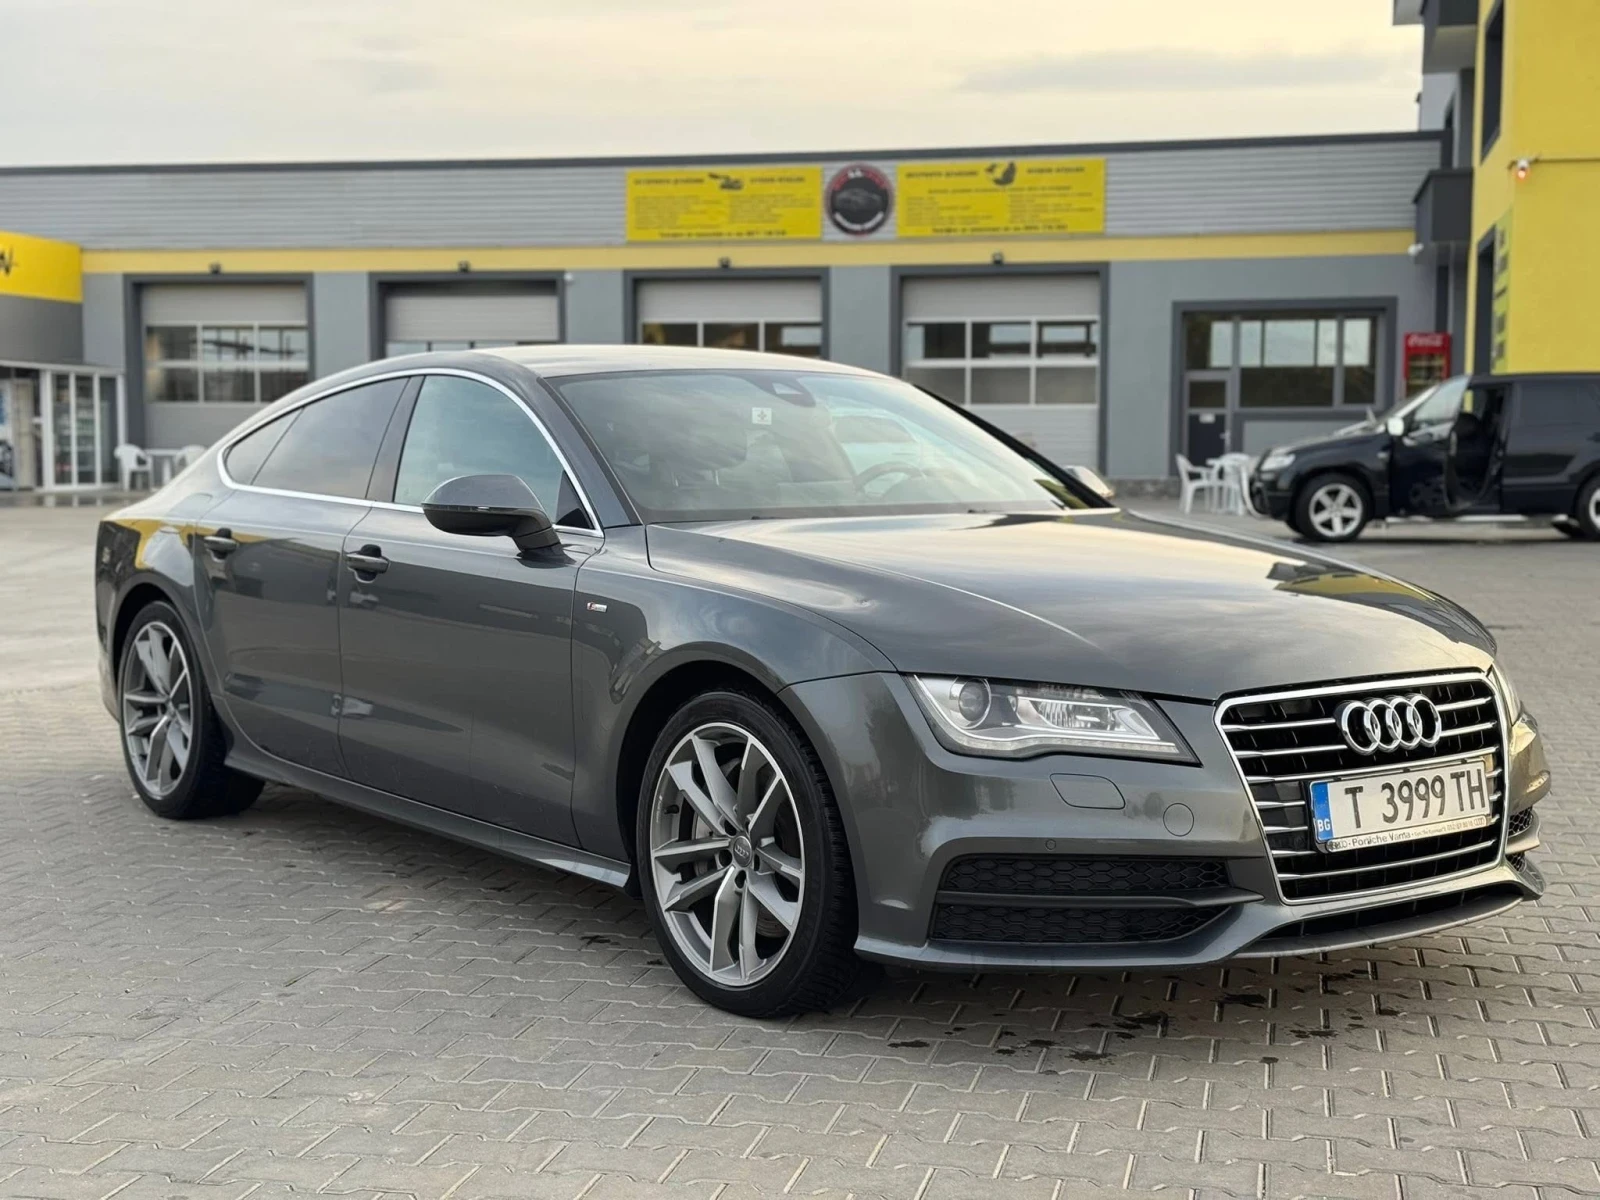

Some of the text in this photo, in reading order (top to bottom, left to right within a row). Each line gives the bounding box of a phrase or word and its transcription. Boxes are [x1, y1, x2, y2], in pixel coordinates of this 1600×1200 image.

[1344, 785, 1364, 829] T
[1380, 774, 1446, 824] 3999
[1450, 768, 1486, 812] TH
[1318, 818, 1331, 832] BG
